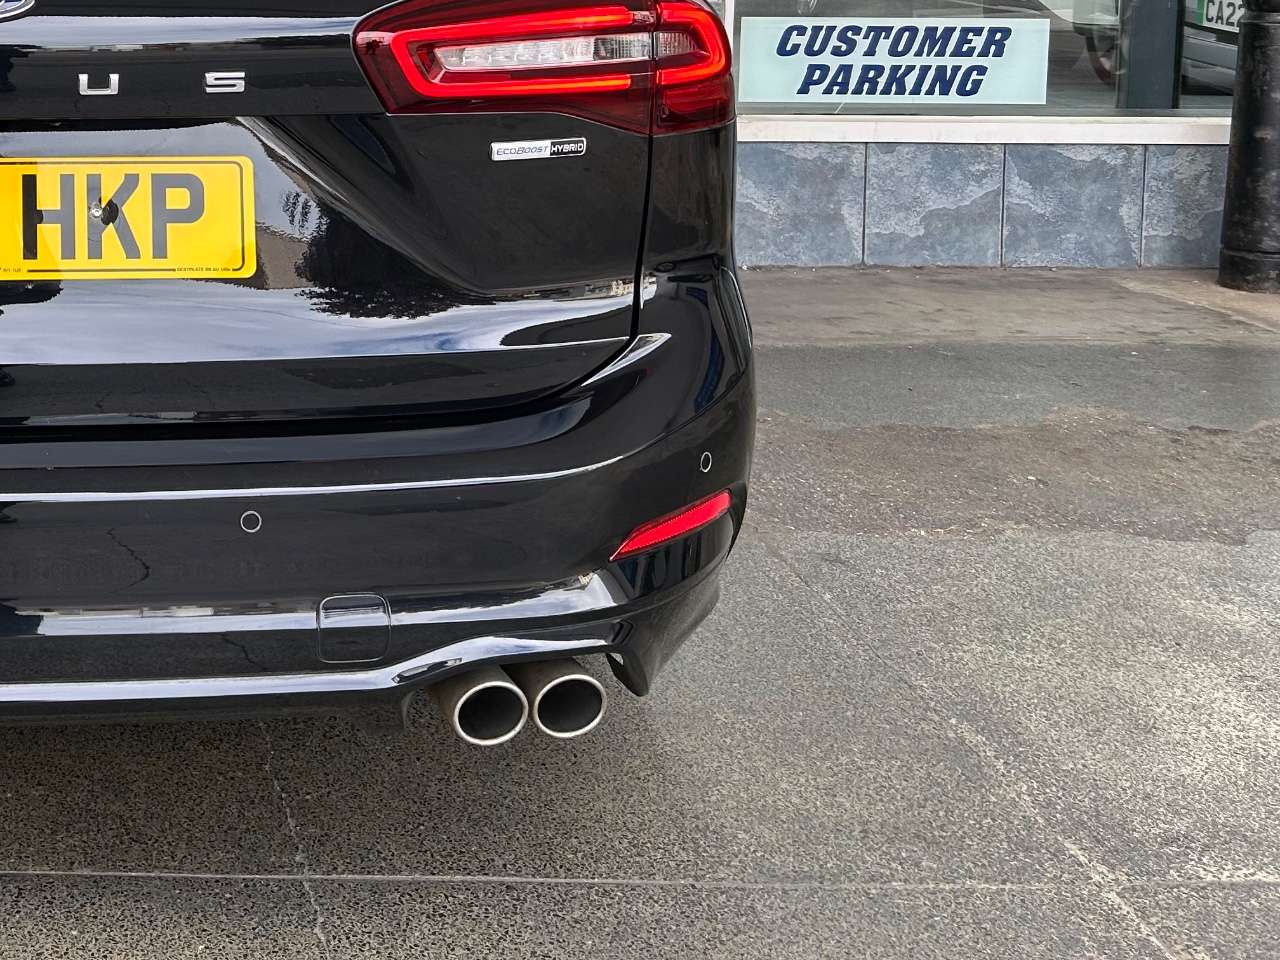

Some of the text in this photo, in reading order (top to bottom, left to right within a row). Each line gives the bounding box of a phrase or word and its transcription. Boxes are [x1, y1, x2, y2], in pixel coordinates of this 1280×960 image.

[776, 24, 1013, 58] CUSTOMER
[796, 63, 989, 97] PARKING
[550, 143, 585, 154] HYBRID
[21, 172, 205, 262] HKP
